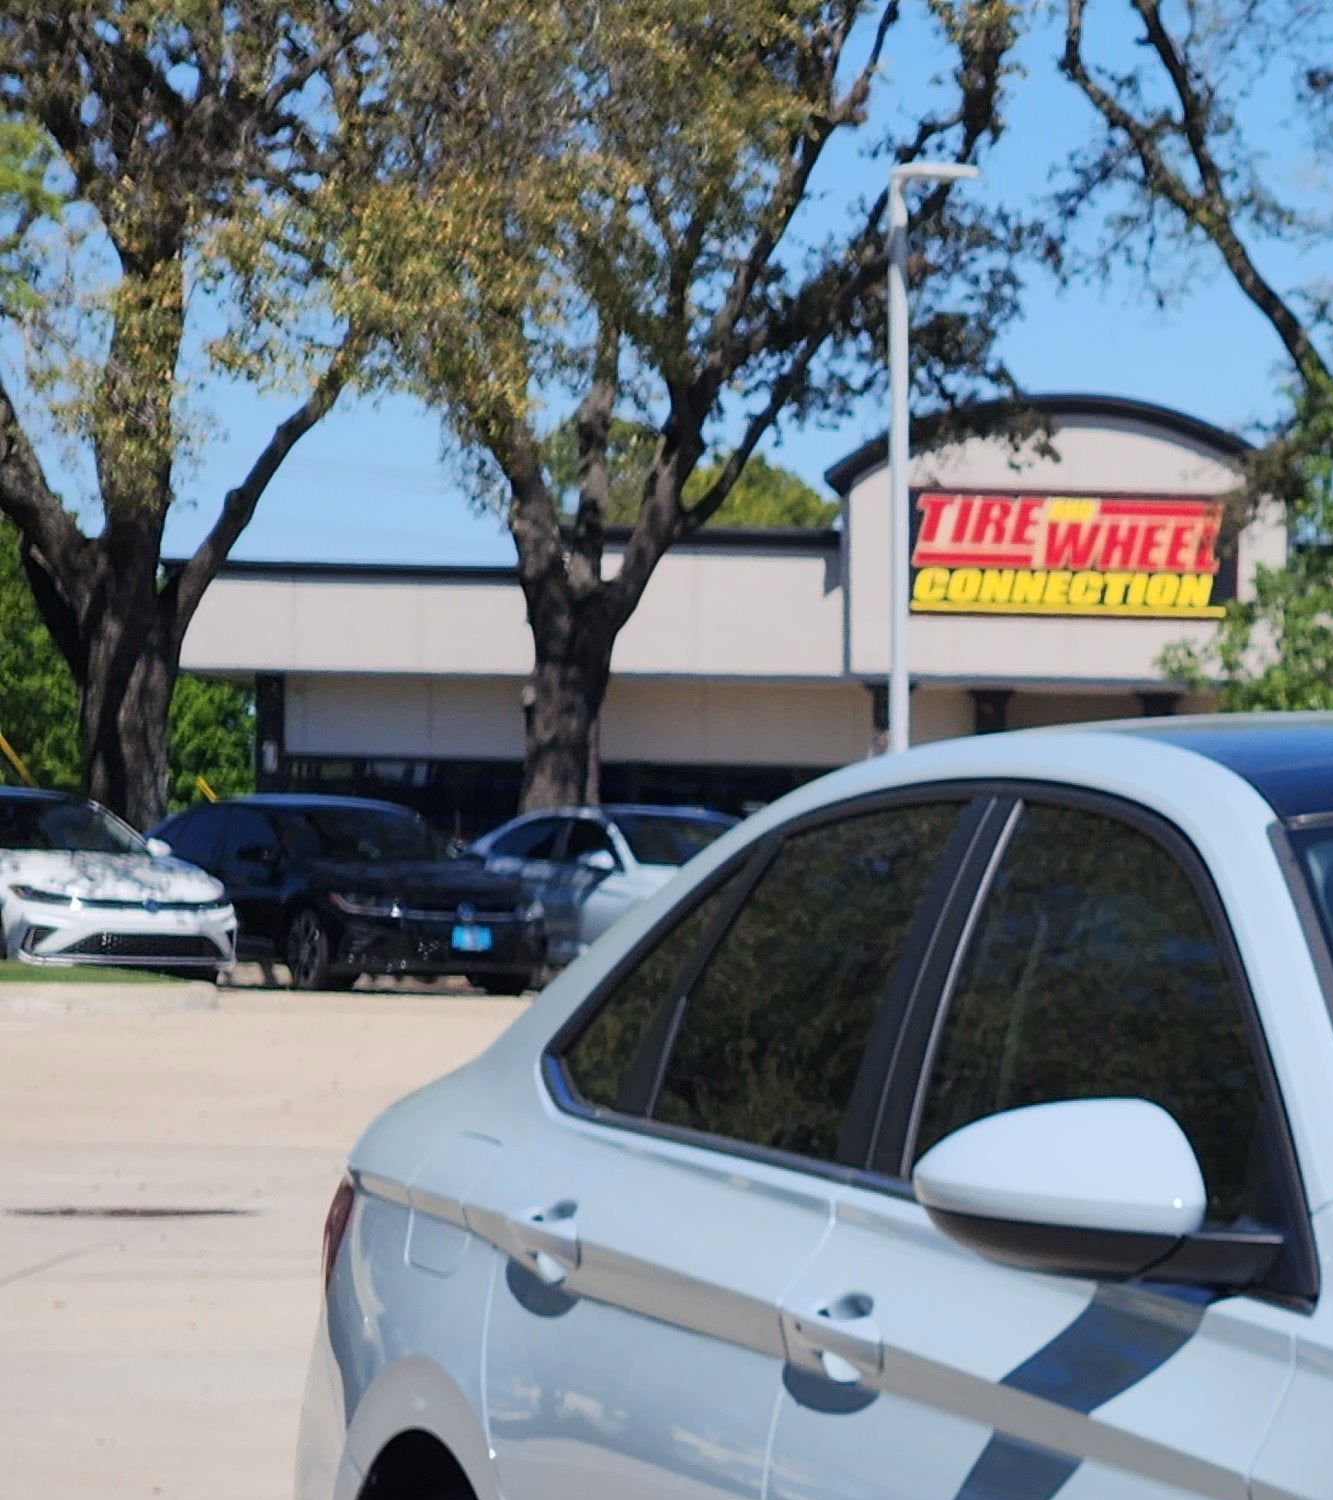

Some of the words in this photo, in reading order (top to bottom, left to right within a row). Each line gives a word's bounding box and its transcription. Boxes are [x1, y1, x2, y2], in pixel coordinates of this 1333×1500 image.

[919, 496, 1045, 545] TIRE
[1045, 521, 1218, 571] WHEEL
[913, 567, 1213, 606] CONNECTION
